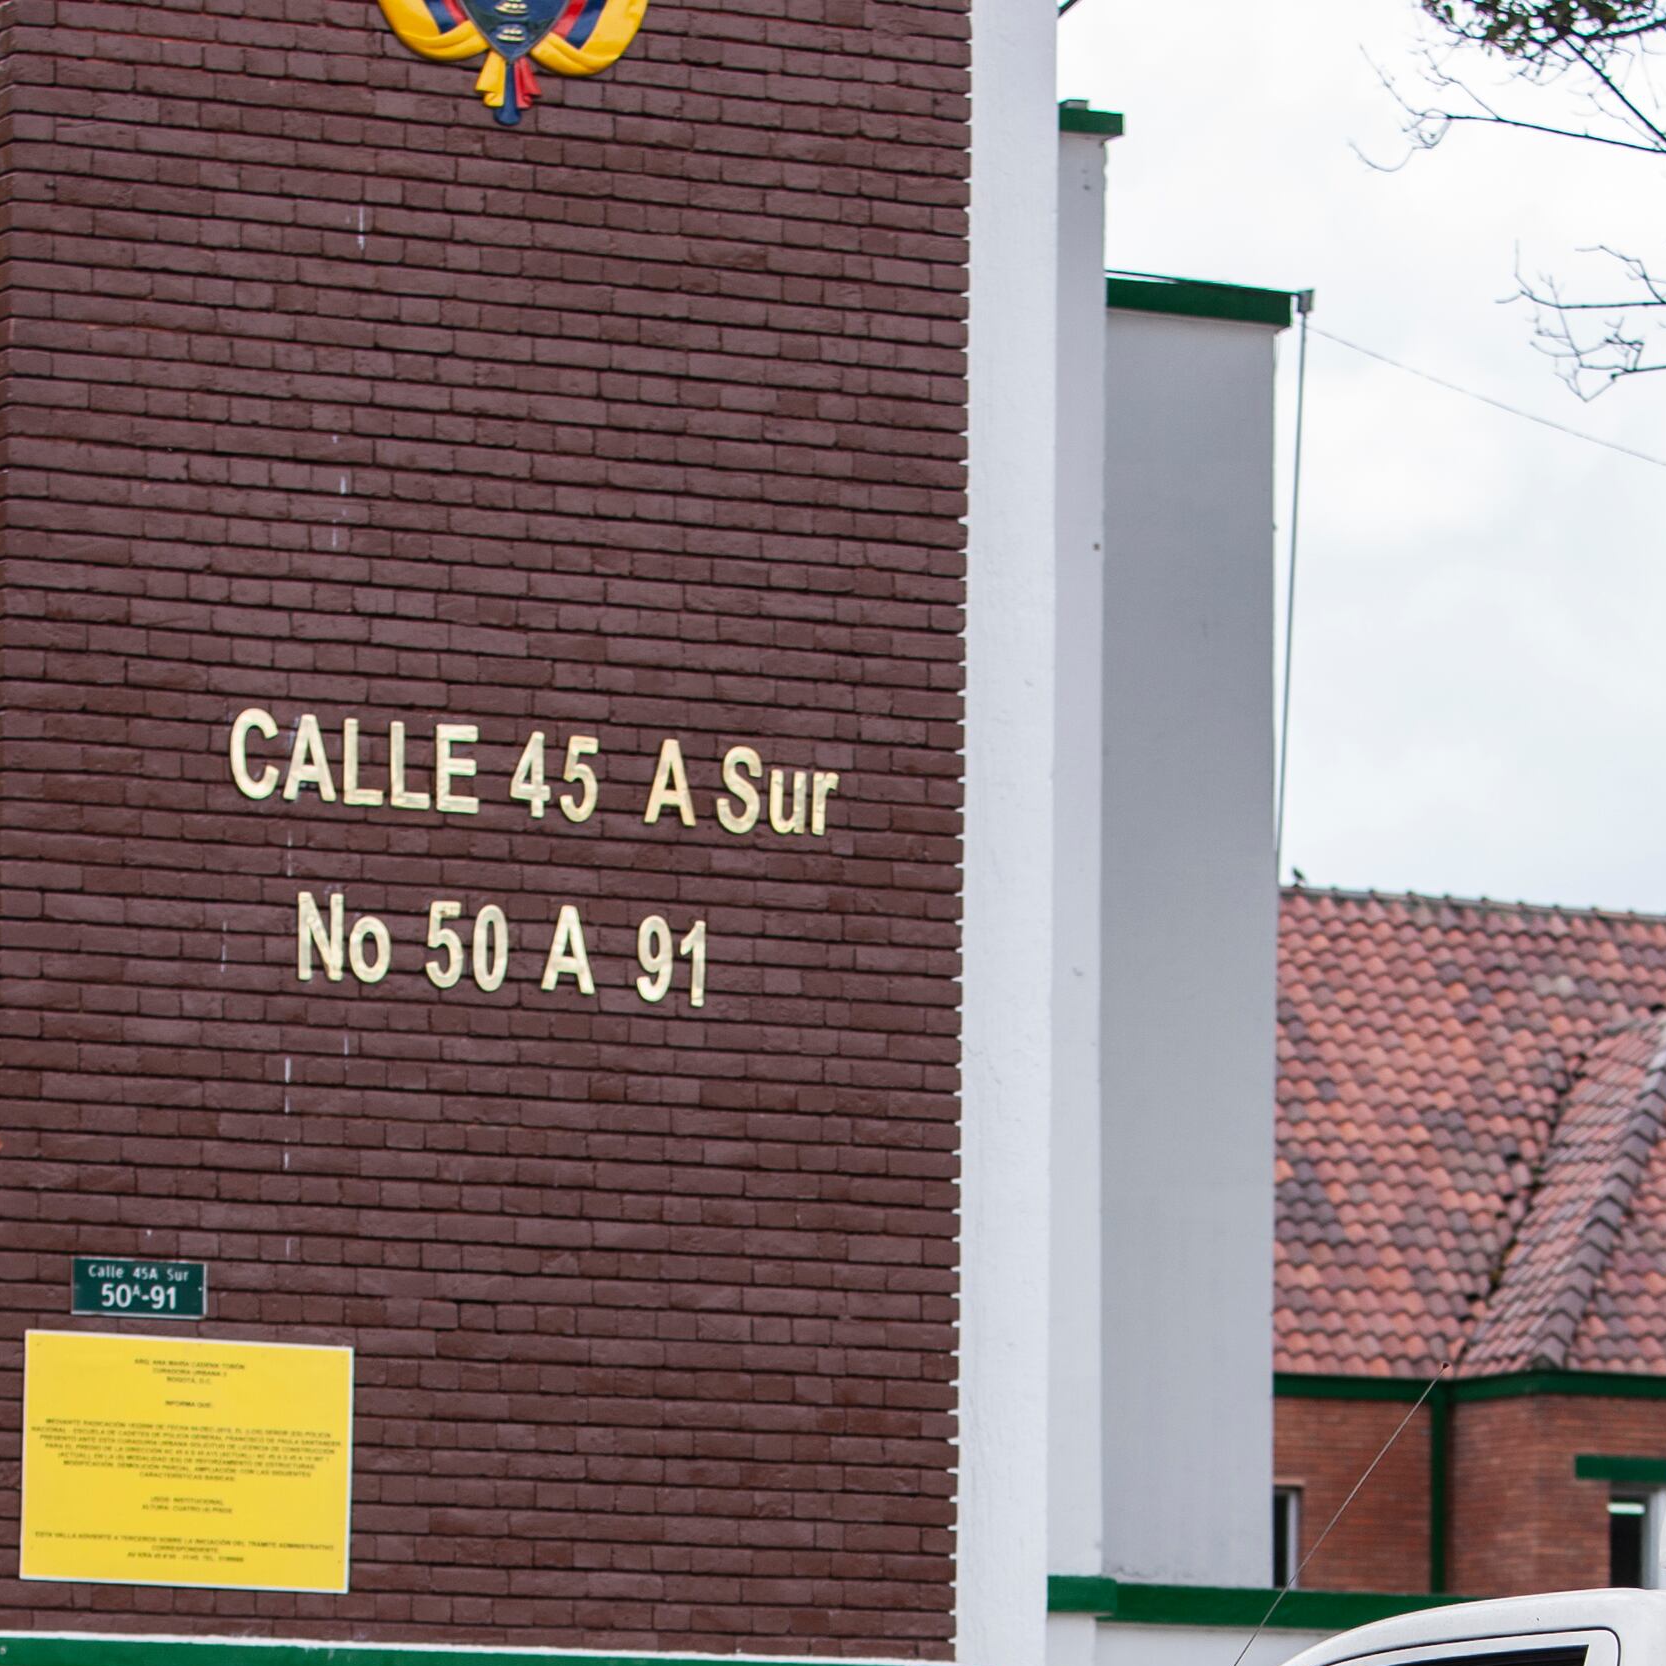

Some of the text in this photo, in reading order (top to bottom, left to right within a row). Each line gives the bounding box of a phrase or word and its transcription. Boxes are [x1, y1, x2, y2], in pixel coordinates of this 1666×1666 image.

[230, 707, 840, 837] CALLE 45 A Sur
[296, 890, 706, 1008] No 50 A 91
[88, 1264, 189, 1282] Calle 45A Sur
